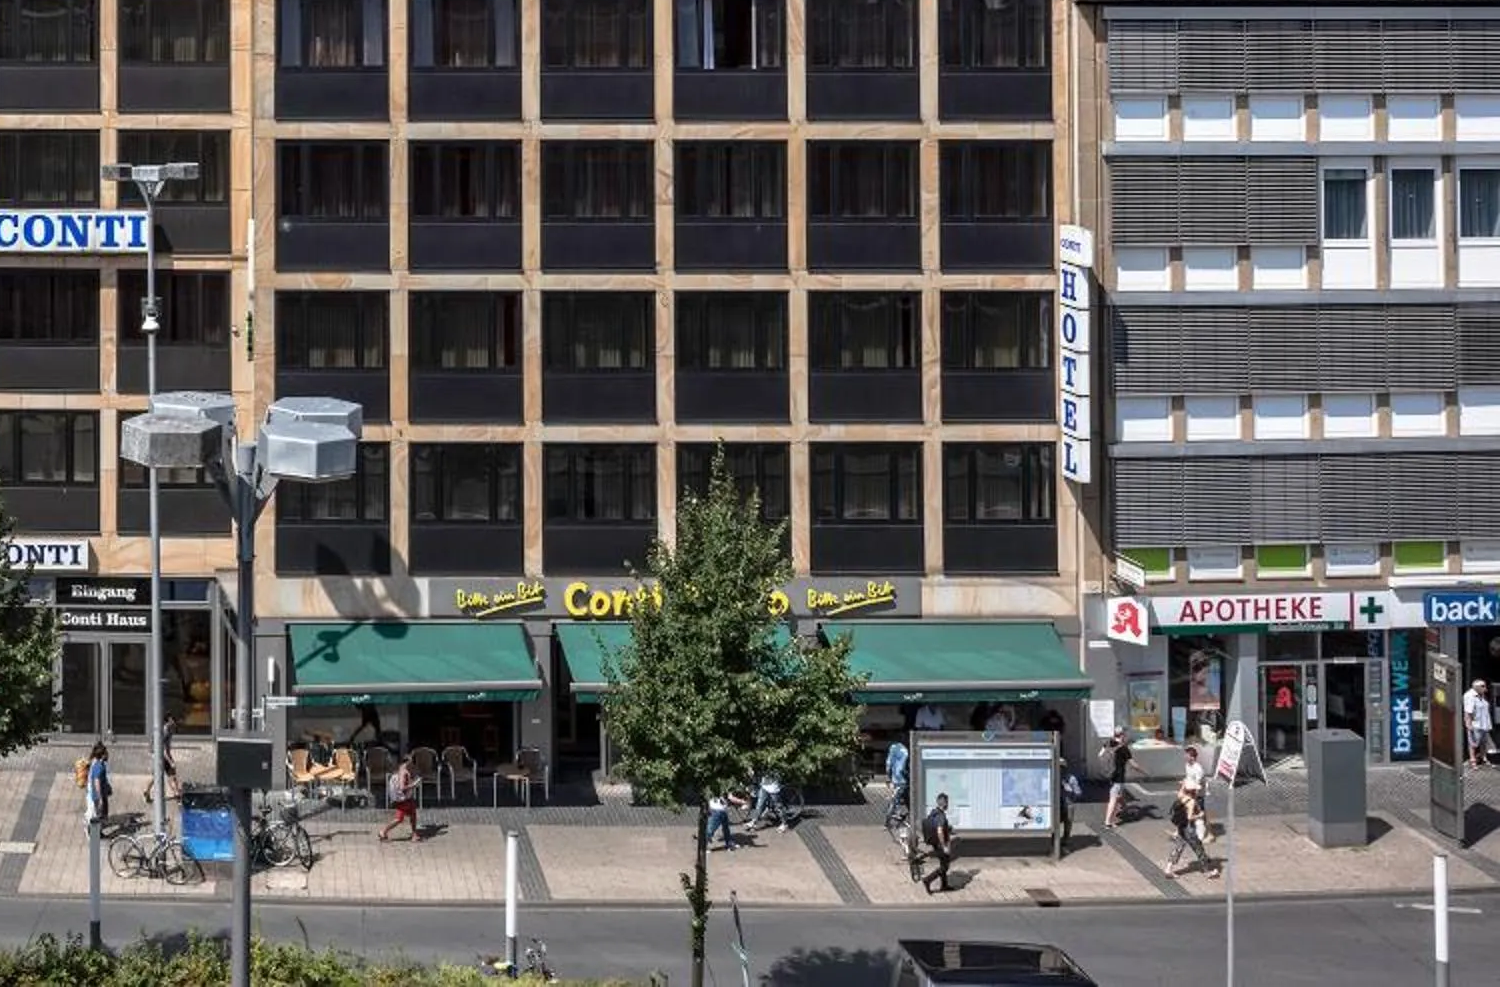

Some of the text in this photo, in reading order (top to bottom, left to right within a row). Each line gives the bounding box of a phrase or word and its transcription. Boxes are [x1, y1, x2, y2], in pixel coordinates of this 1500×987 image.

[1061, 267, 1078, 476] HOTEL
[5, 544, 82, 565] ONTI
[70, 584, 137, 600] Eingang
[517, 580, 545, 599] Bit
[807, 588, 839, 609] Bitte
[867, 580, 895, 599] Bit
[62, 612, 147, 626] Conti Haus
[1179, 596, 1323, 623] APOTHEKE
[1431, 596, 1495, 622] back
[1392, 696, 1412, 753] back
